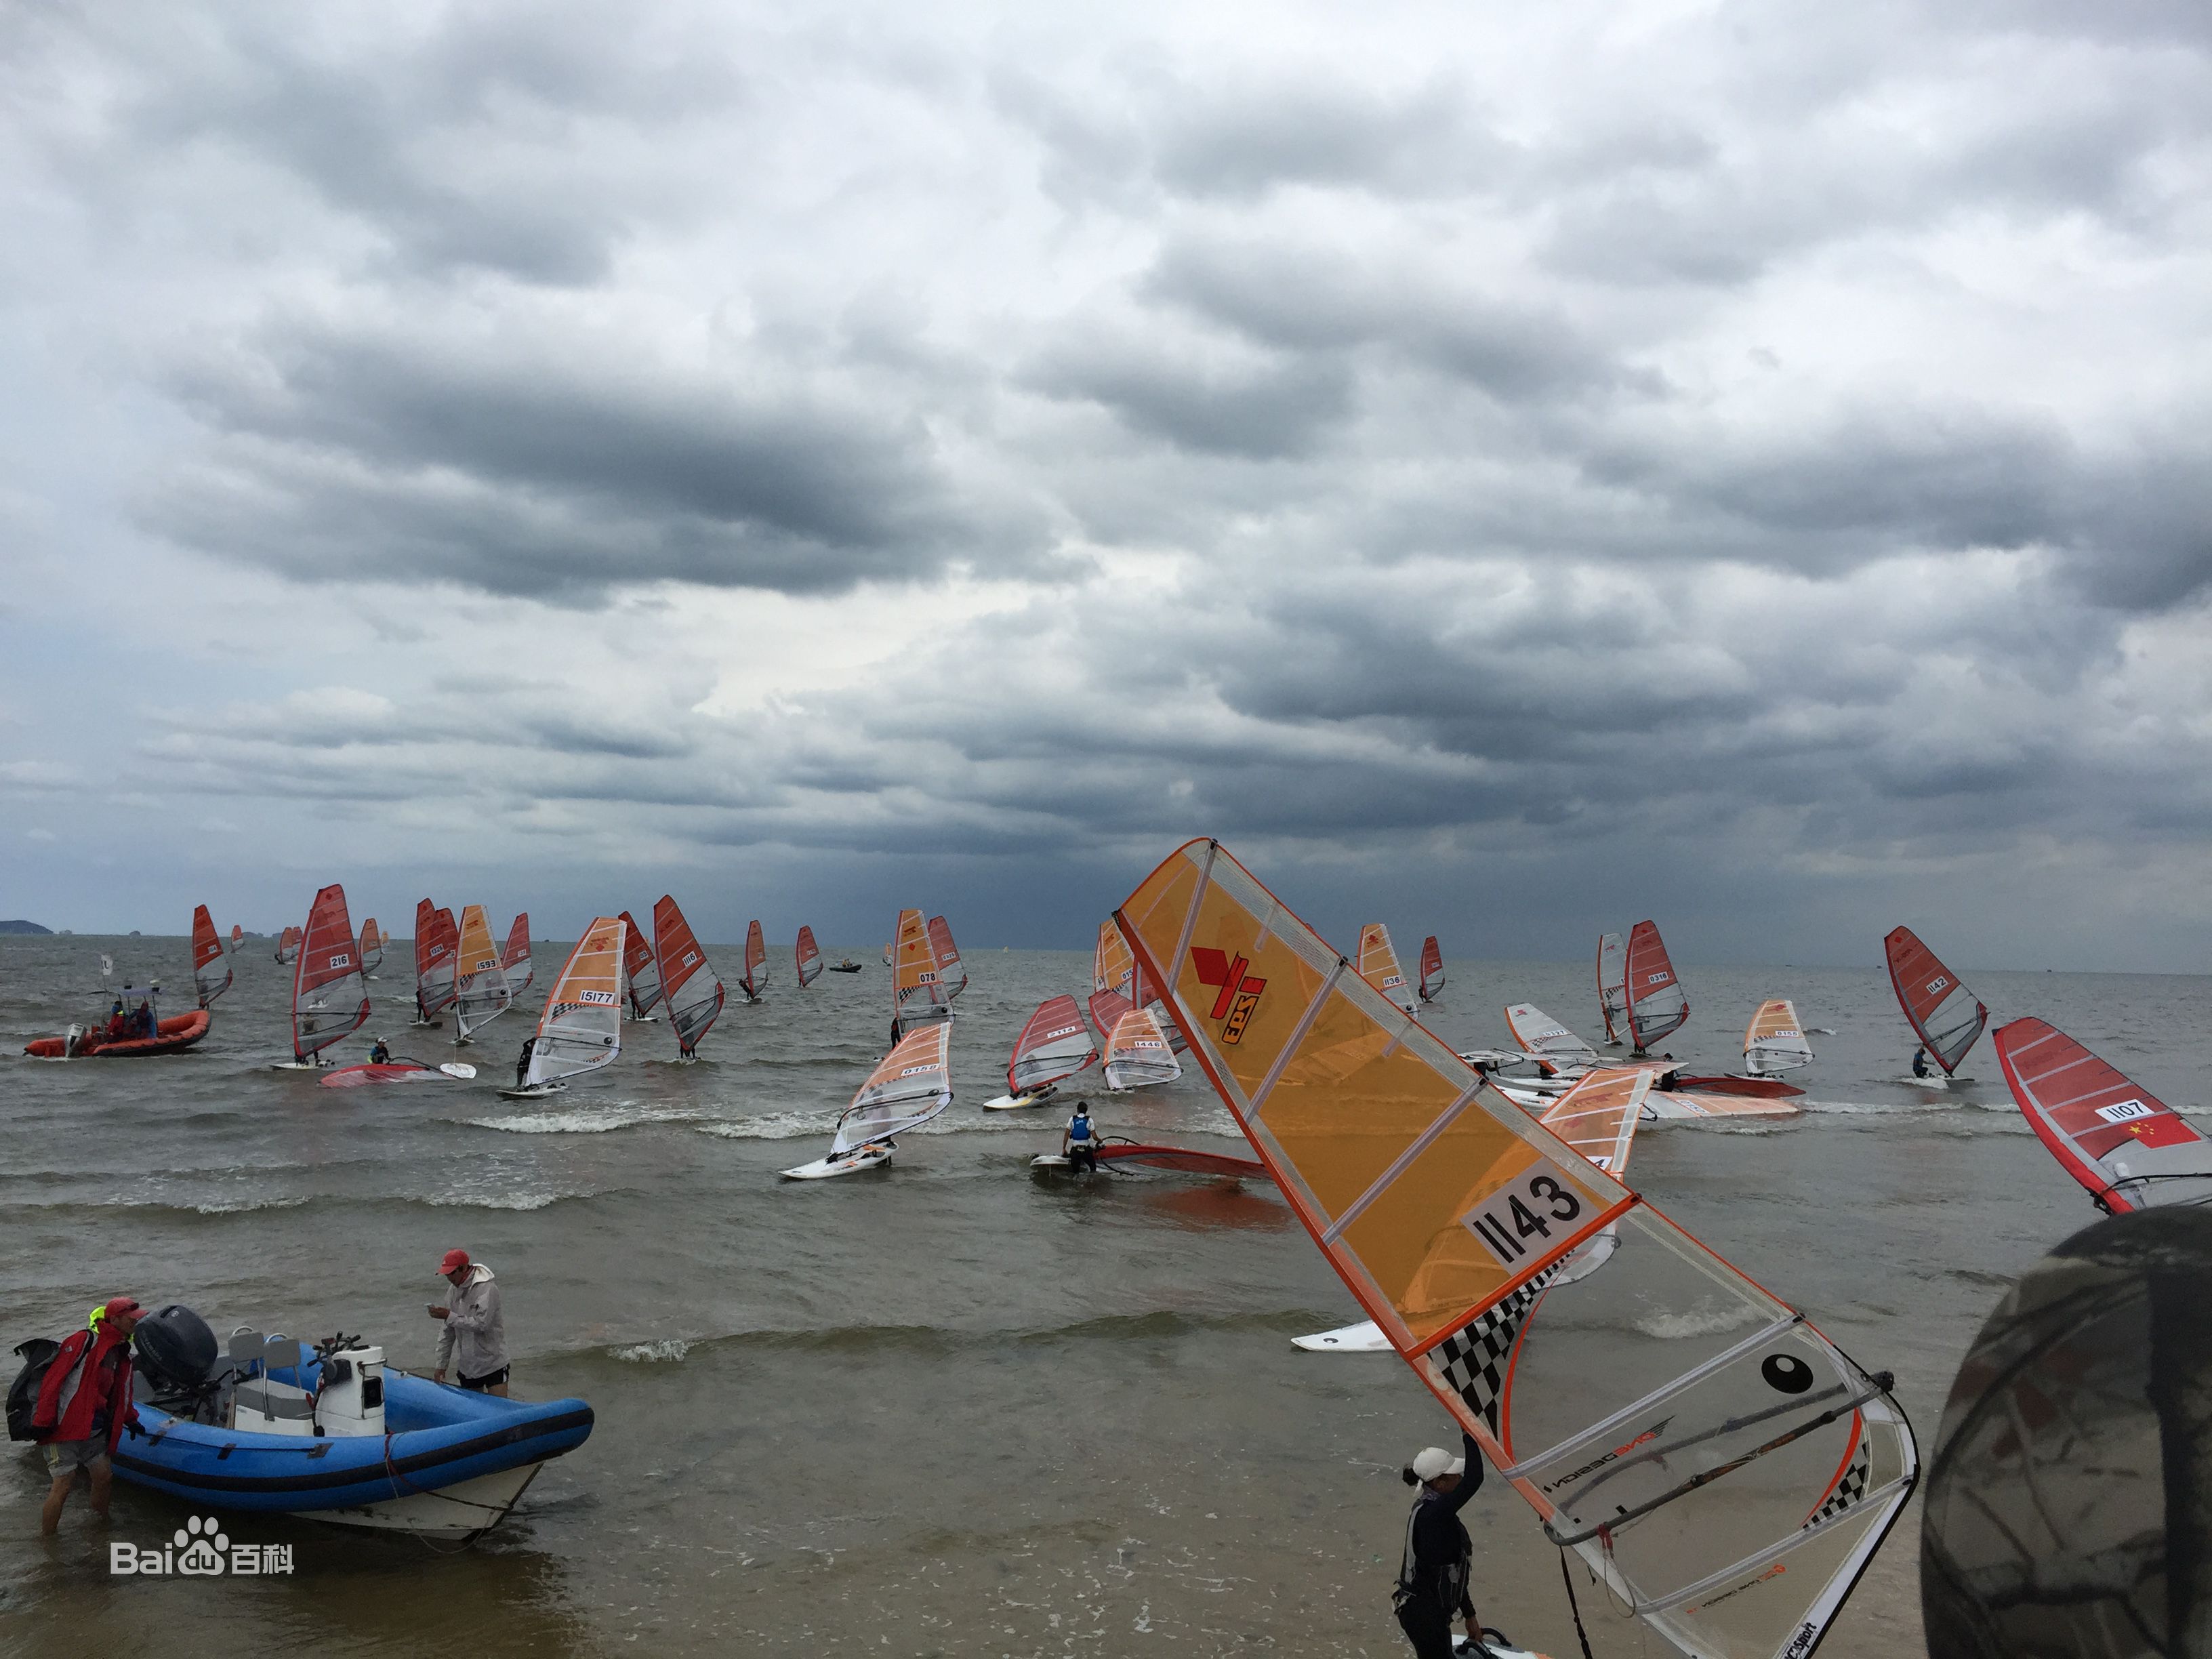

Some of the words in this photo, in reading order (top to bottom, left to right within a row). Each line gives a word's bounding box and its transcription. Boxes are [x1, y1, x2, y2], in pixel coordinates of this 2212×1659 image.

[331, 956, 347, 967] 216
[683, 953, 695, 965] 1116
[477, 960, 496, 970] 1593
[920, 973, 935, 983] 078
[1385, 977, 1400, 986] 1136
[1927, 978, 1946, 993] 1142
[581, 991, 613, 1004] 15177
[1050, 1027, 1073, 1037] 2114
[2106, 1102, 2144, 1119] 1107
[1473, 1176, 1580, 1263] 1143
